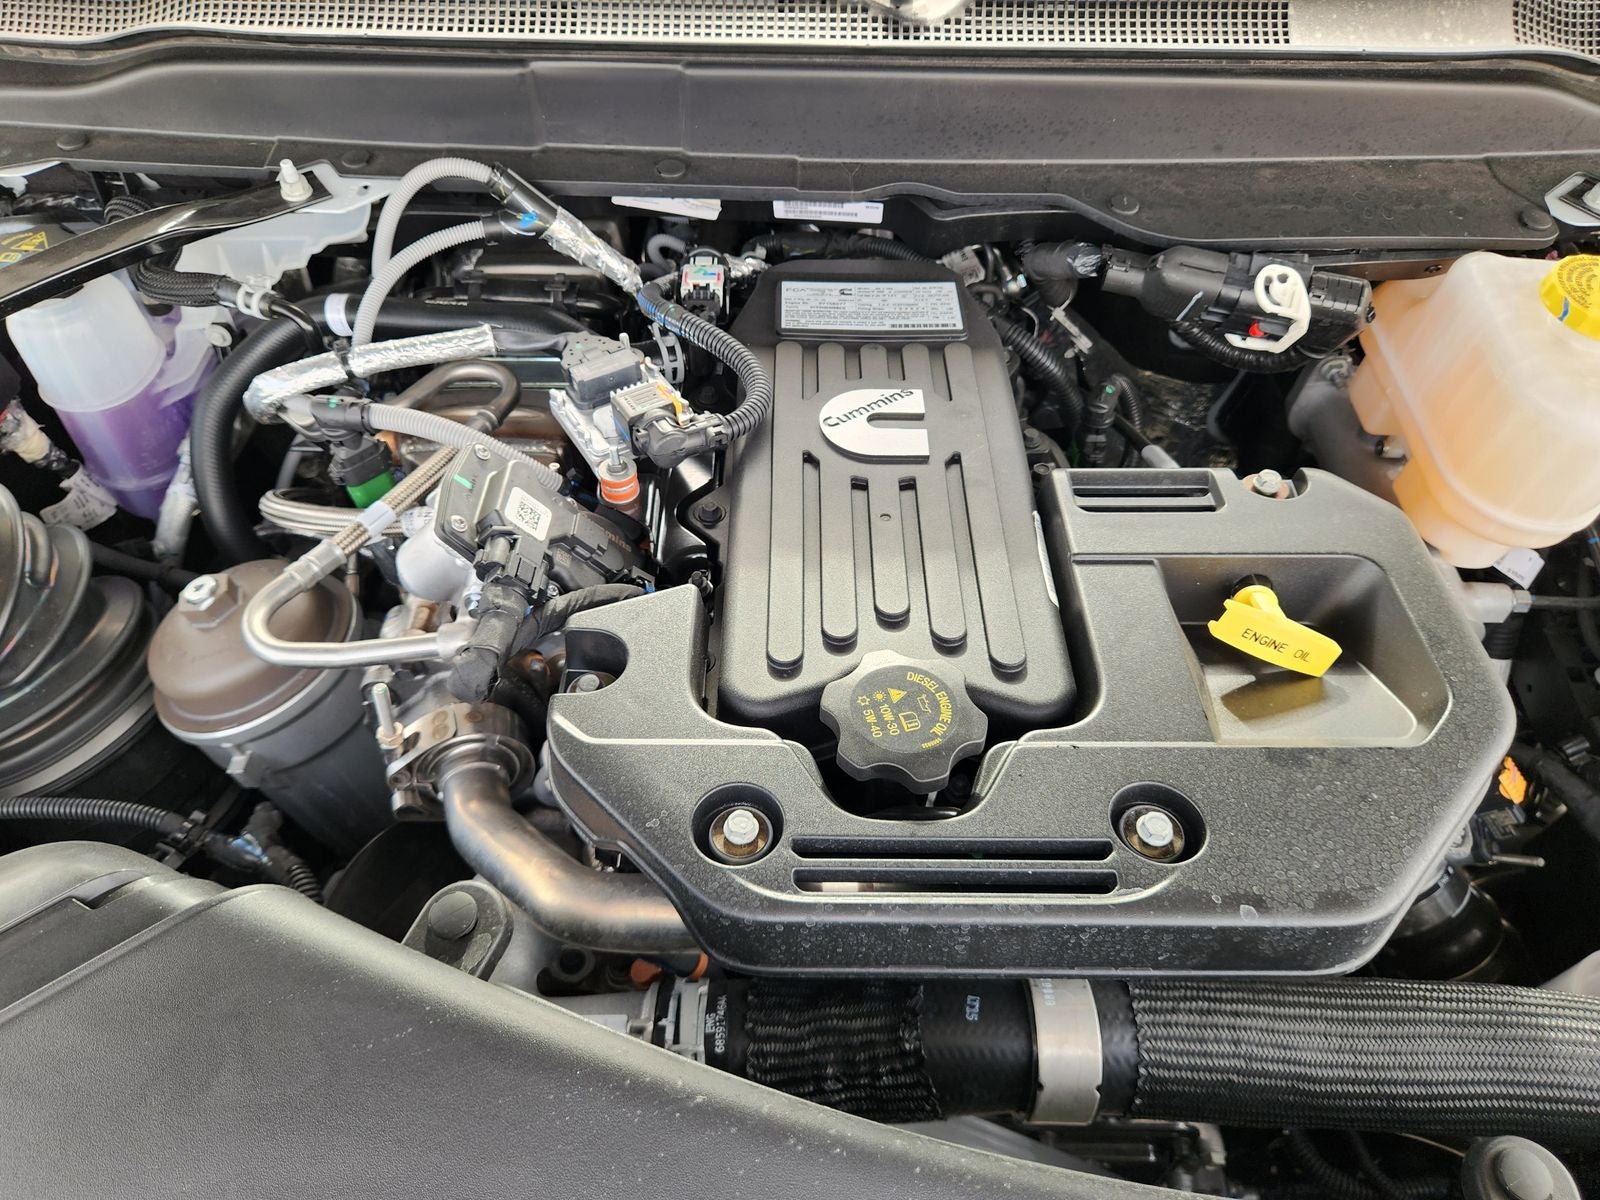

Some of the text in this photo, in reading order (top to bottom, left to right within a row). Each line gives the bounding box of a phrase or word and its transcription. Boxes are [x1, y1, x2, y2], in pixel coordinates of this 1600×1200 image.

[822, 388, 914, 427] Cummins
[1241, 628, 1311, 662] ENGINE OIL
[907, 671, 938, 693] DIESEL
[863, 708, 883, 738] 5W-40
[879, 703, 900, 736] 10W-30
[936, 692, 953, 724] ENGINE
[930, 722, 947, 737] OIL
[705, 1012, 716, 1033] ENG
